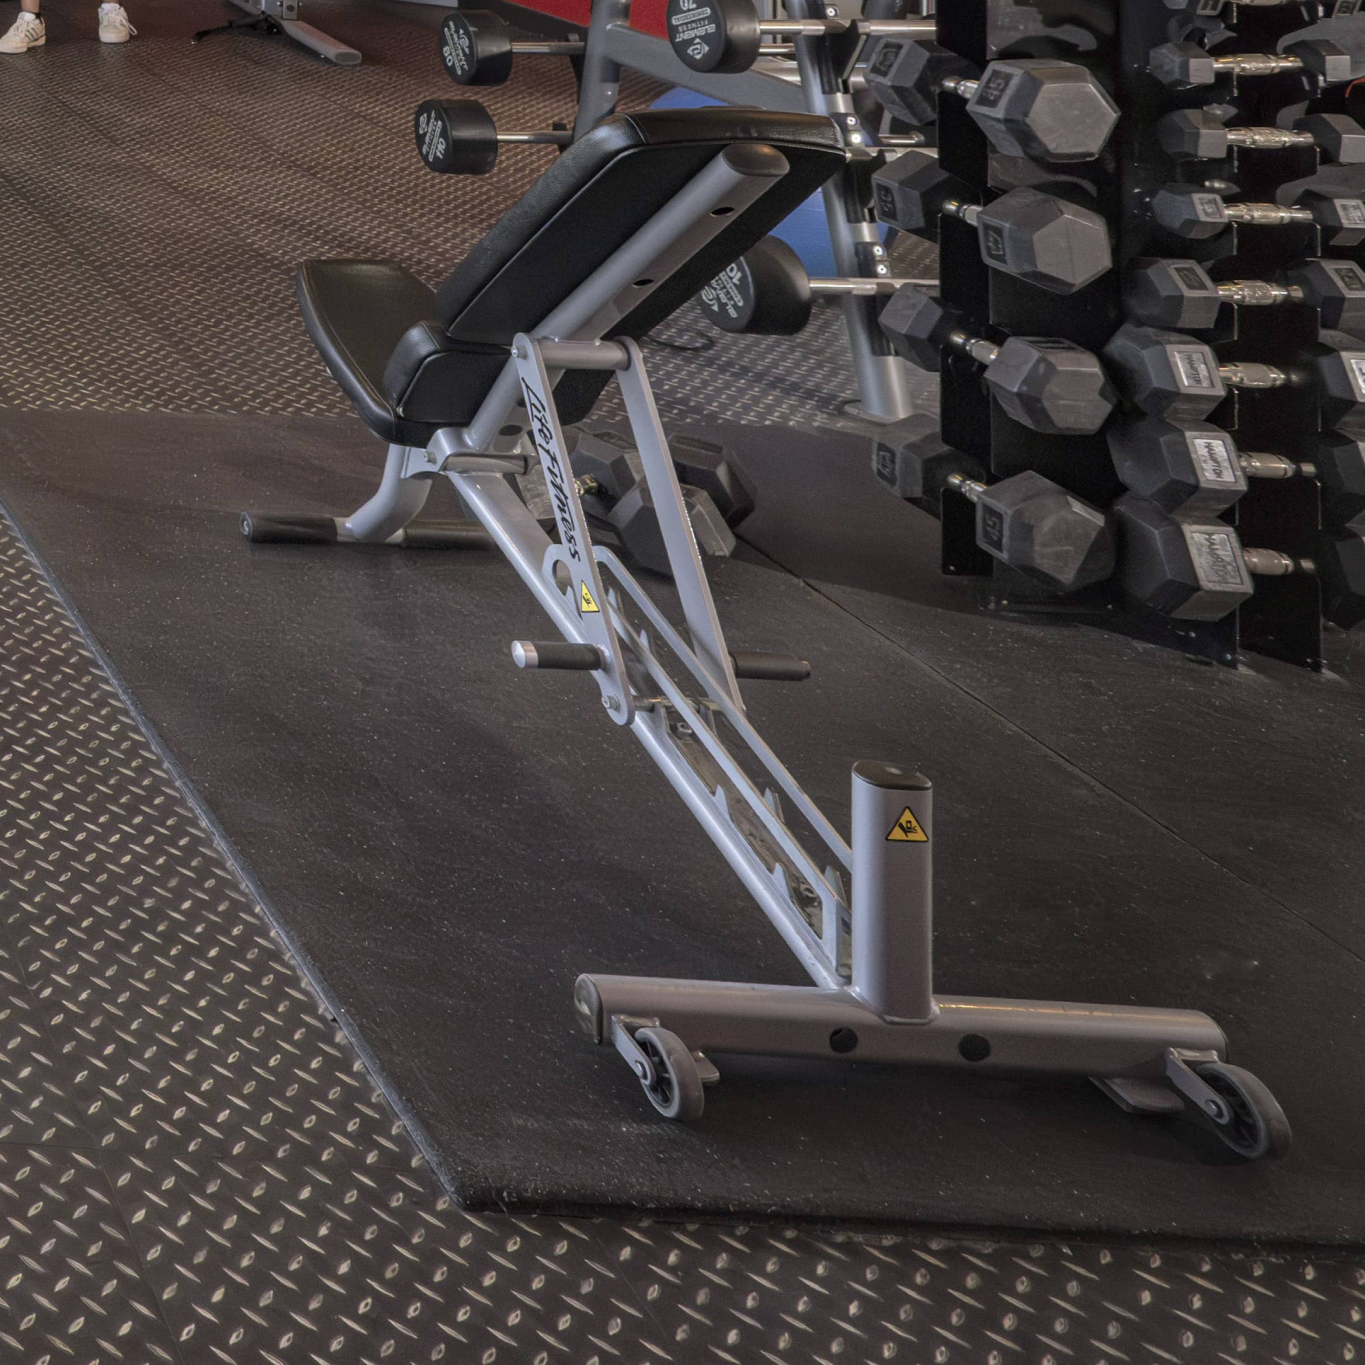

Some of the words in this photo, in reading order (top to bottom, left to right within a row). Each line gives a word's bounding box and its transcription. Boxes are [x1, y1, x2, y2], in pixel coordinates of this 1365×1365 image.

[675, 24, 716, 42] ELEMENT
[443, 46, 453, 67] 80
[422, 110, 436, 155] ELEMENT
[436, 137, 446, 159] 110
[726, 263, 742, 285] 10
[521, 376, 554, 446] Life
[538, 442, 581, 563] Fitness
[1203, 441, 1225, 480] HAMPTON
